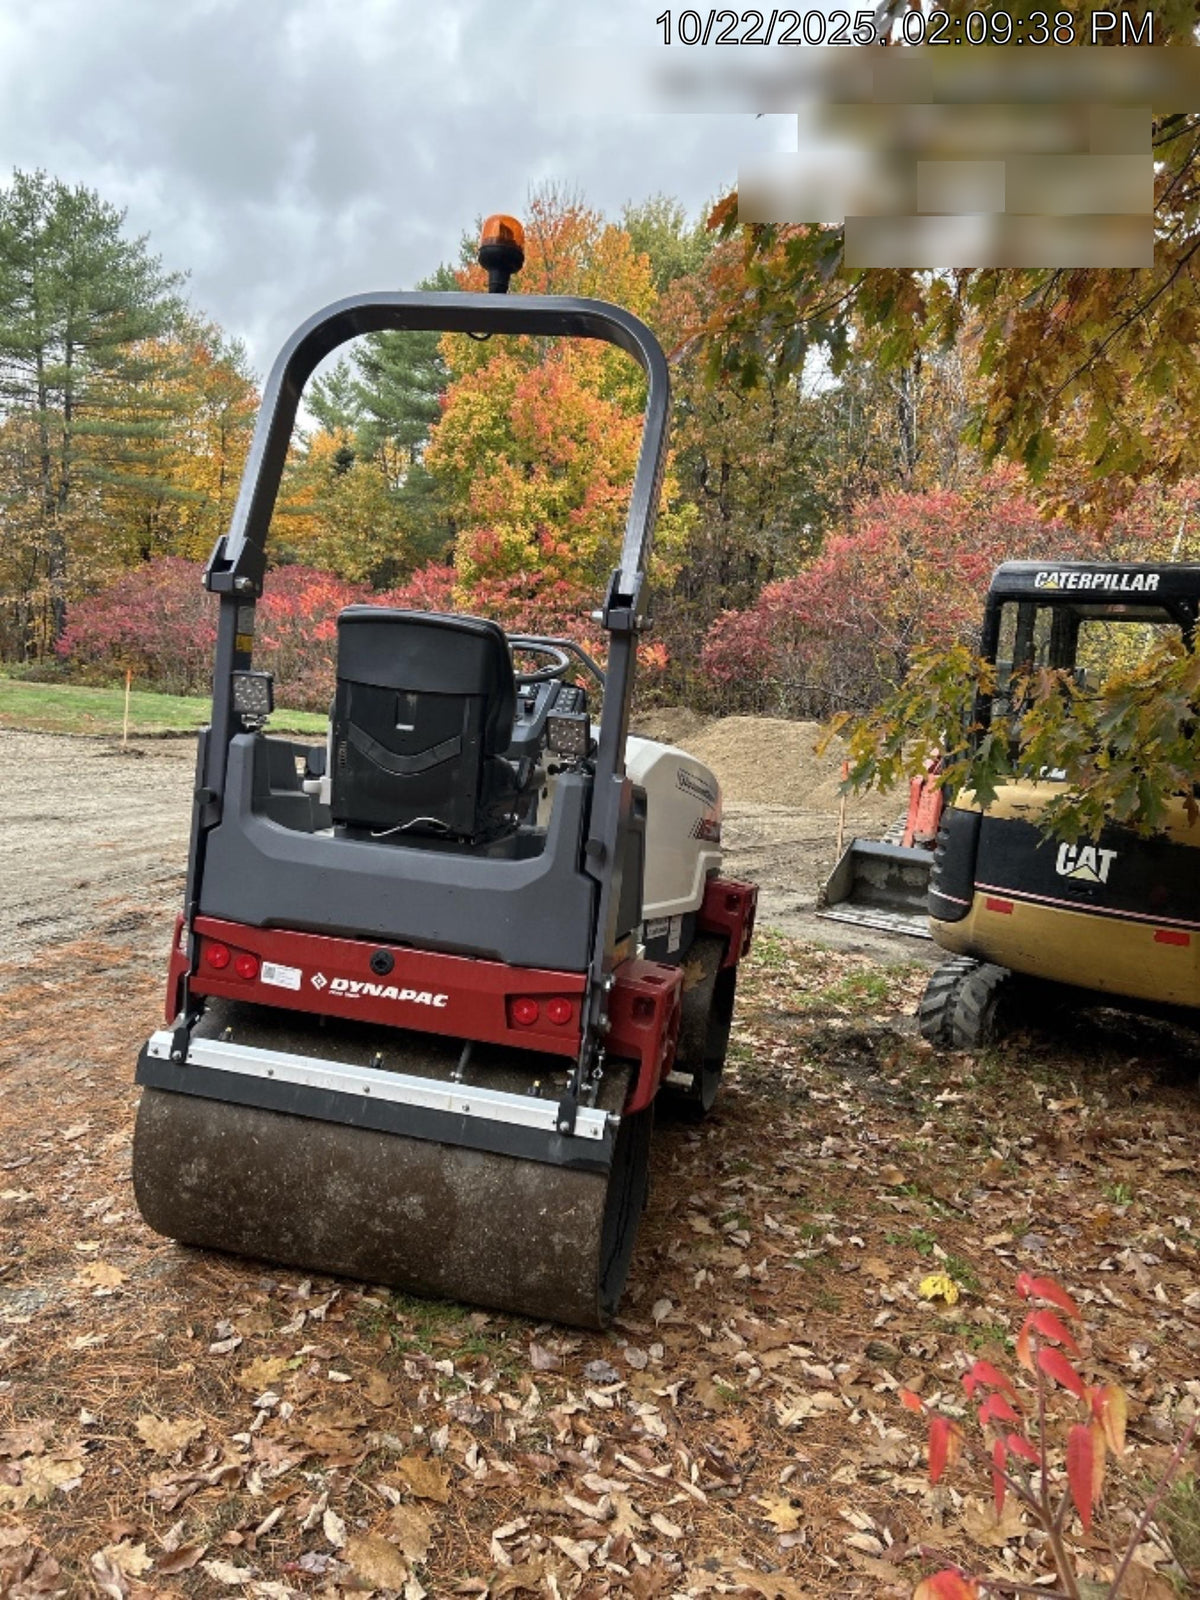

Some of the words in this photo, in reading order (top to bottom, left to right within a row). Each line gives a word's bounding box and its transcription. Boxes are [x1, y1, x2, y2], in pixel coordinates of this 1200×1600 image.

[1034, 571, 1160, 591] CATERPILLAR
[1056, 842, 1117, 884] CAT
[329, 978, 448, 1007] DYNAPAC
